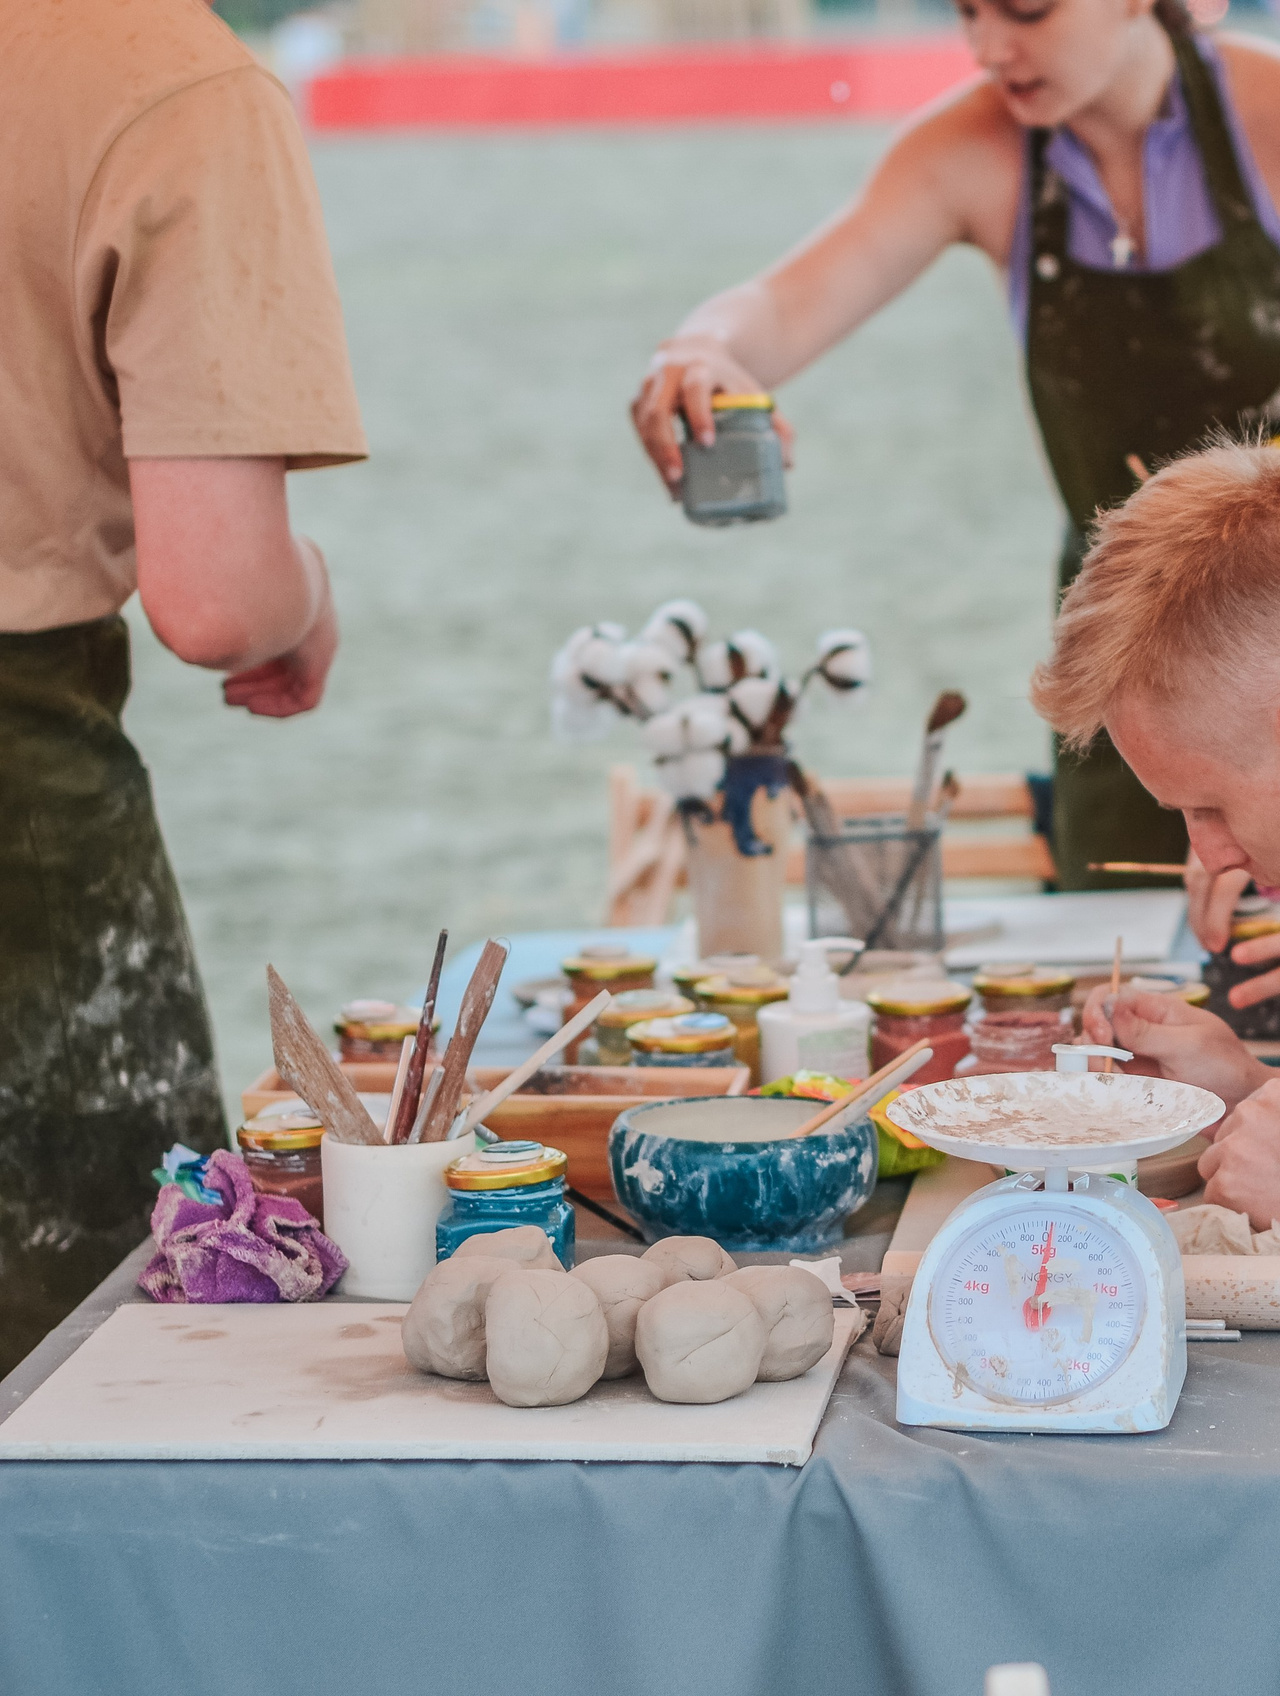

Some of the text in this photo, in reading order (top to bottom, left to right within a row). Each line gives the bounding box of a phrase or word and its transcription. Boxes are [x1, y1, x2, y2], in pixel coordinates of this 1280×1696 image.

[1020, 1233, 1035, 1242] 800
[1057, 1234, 1073, 1243] 200
[1073, 1242, 1088, 1250] 400
[986, 1249, 1002, 1258] 400
[1031, 1244, 1056, 1258] 5kg
[1088, 1253, 1104, 1262] 600
[973, 1264, 988, 1272] 200
[1097, 1267, 1113, 1276] 800
[963, 1280, 990, 1295] 4kg
[1092, 1282, 1118, 1297] 1kg
[1108, 1301, 1123, 1309] 200
[1105, 1320, 1120, 1328] 400
[1098, 1337, 1113, 1345] 600
[1087, 1352, 1102, 1360] 800
[1066, 1358, 1091, 1374] 2kg
[1036, 1378, 1052, 1387] 400
